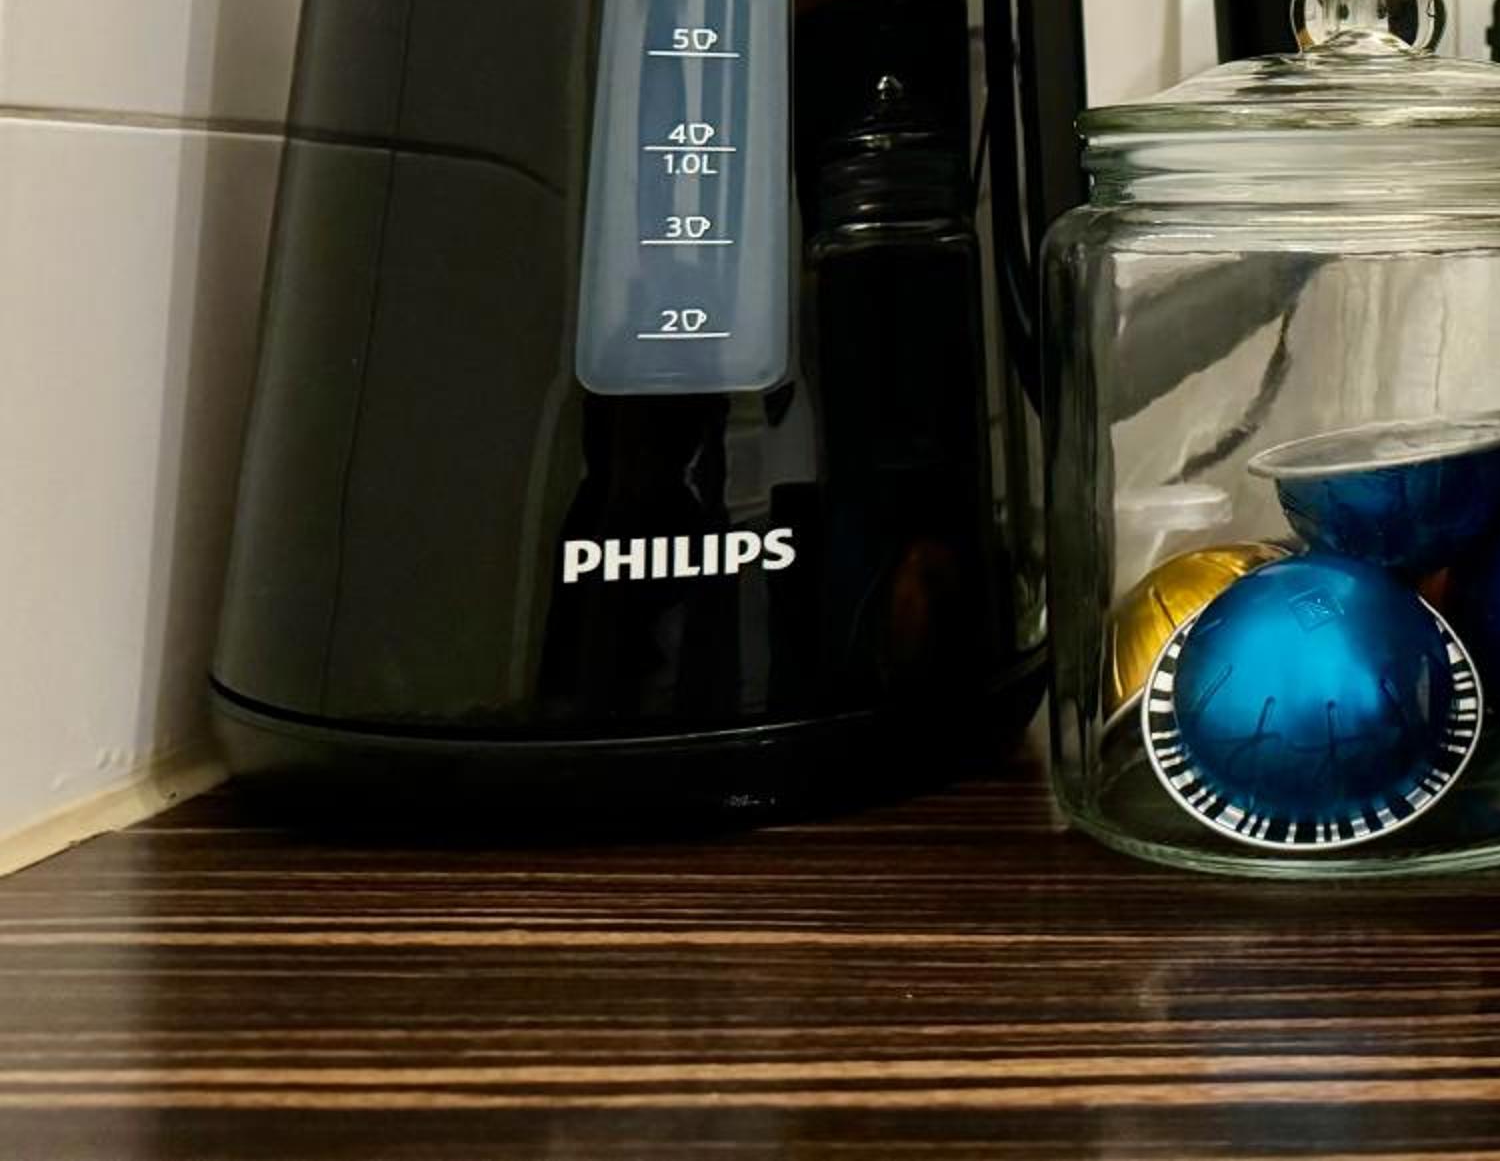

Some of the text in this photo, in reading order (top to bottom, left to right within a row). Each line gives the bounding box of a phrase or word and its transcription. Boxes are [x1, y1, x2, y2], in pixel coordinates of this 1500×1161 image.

[673, 29, 689, 50] 5
[668, 124, 687, 144] 4
[663, 154, 718, 175] 1.0L
[666, 217, 682, 238] 3
[661, 310, 679, 332] 2
[563, 527, 796, 583] PHILIPS
